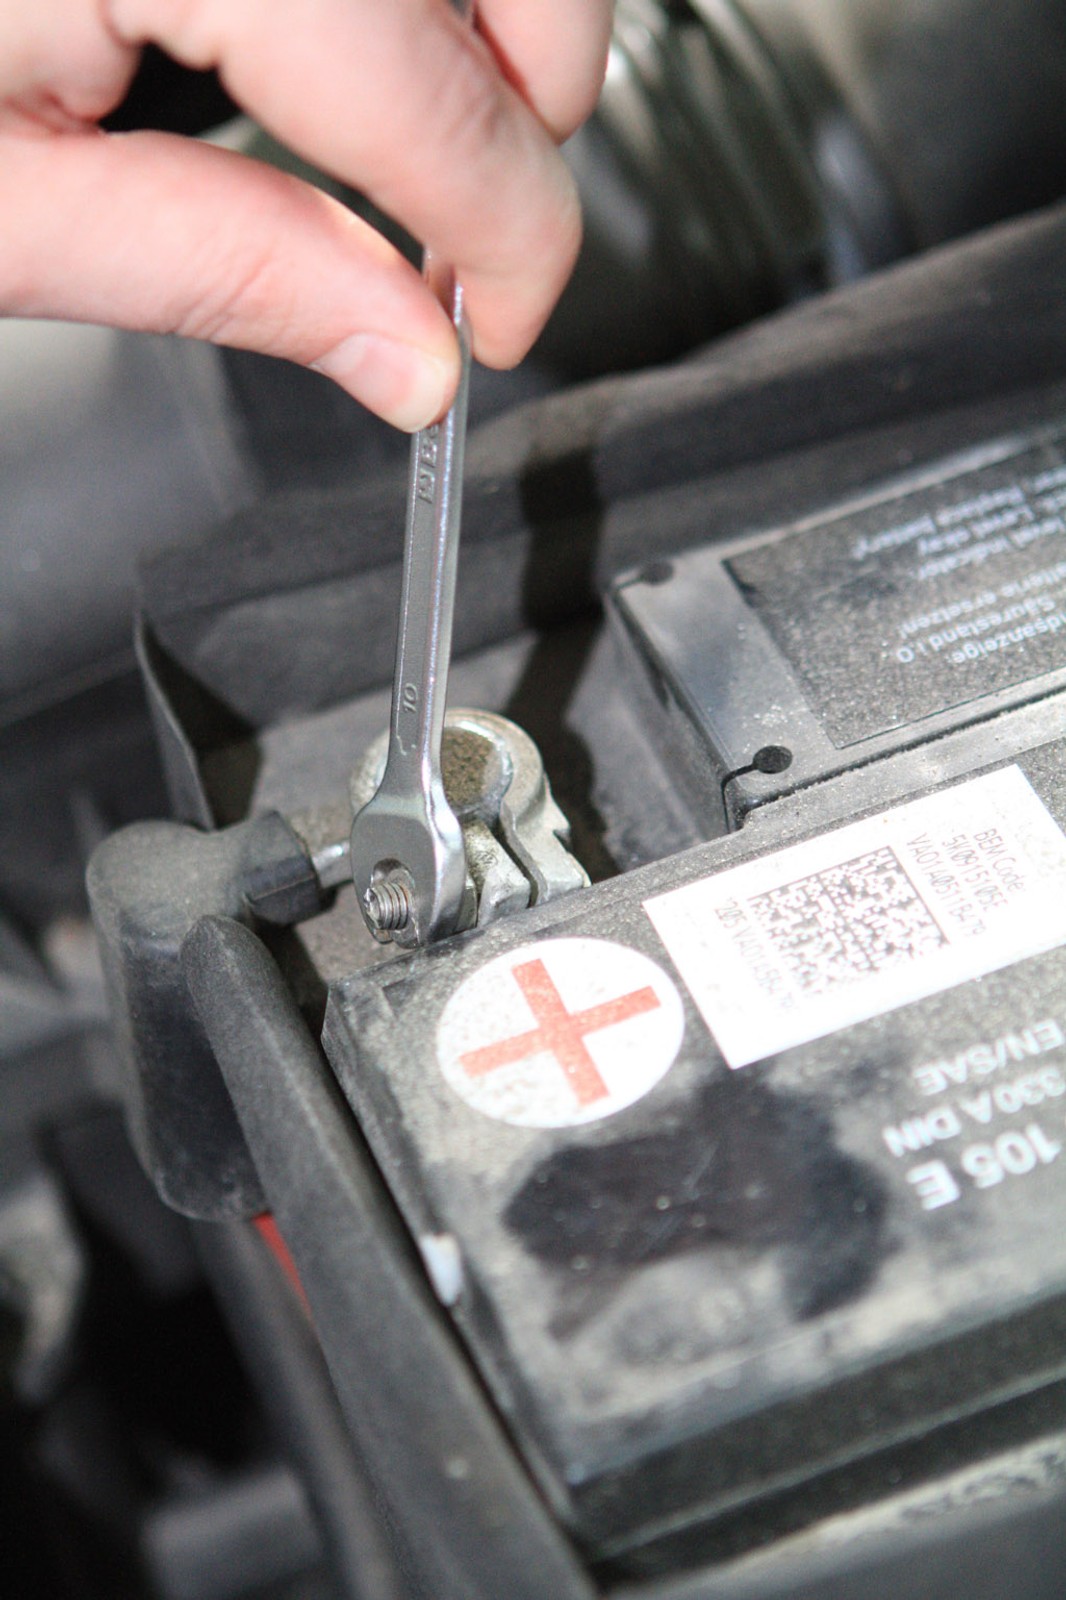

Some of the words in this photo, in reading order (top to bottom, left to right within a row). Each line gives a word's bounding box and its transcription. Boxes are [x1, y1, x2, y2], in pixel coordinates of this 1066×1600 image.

[972, 827, 1009, 861] BEM
[912, 1018, 1065, 1096] EN/SAE
[882, 1105, 961, 1157] DIN
[961, 1122, 1063, 1190] 105
[905, 1160, 961, 1211] E
